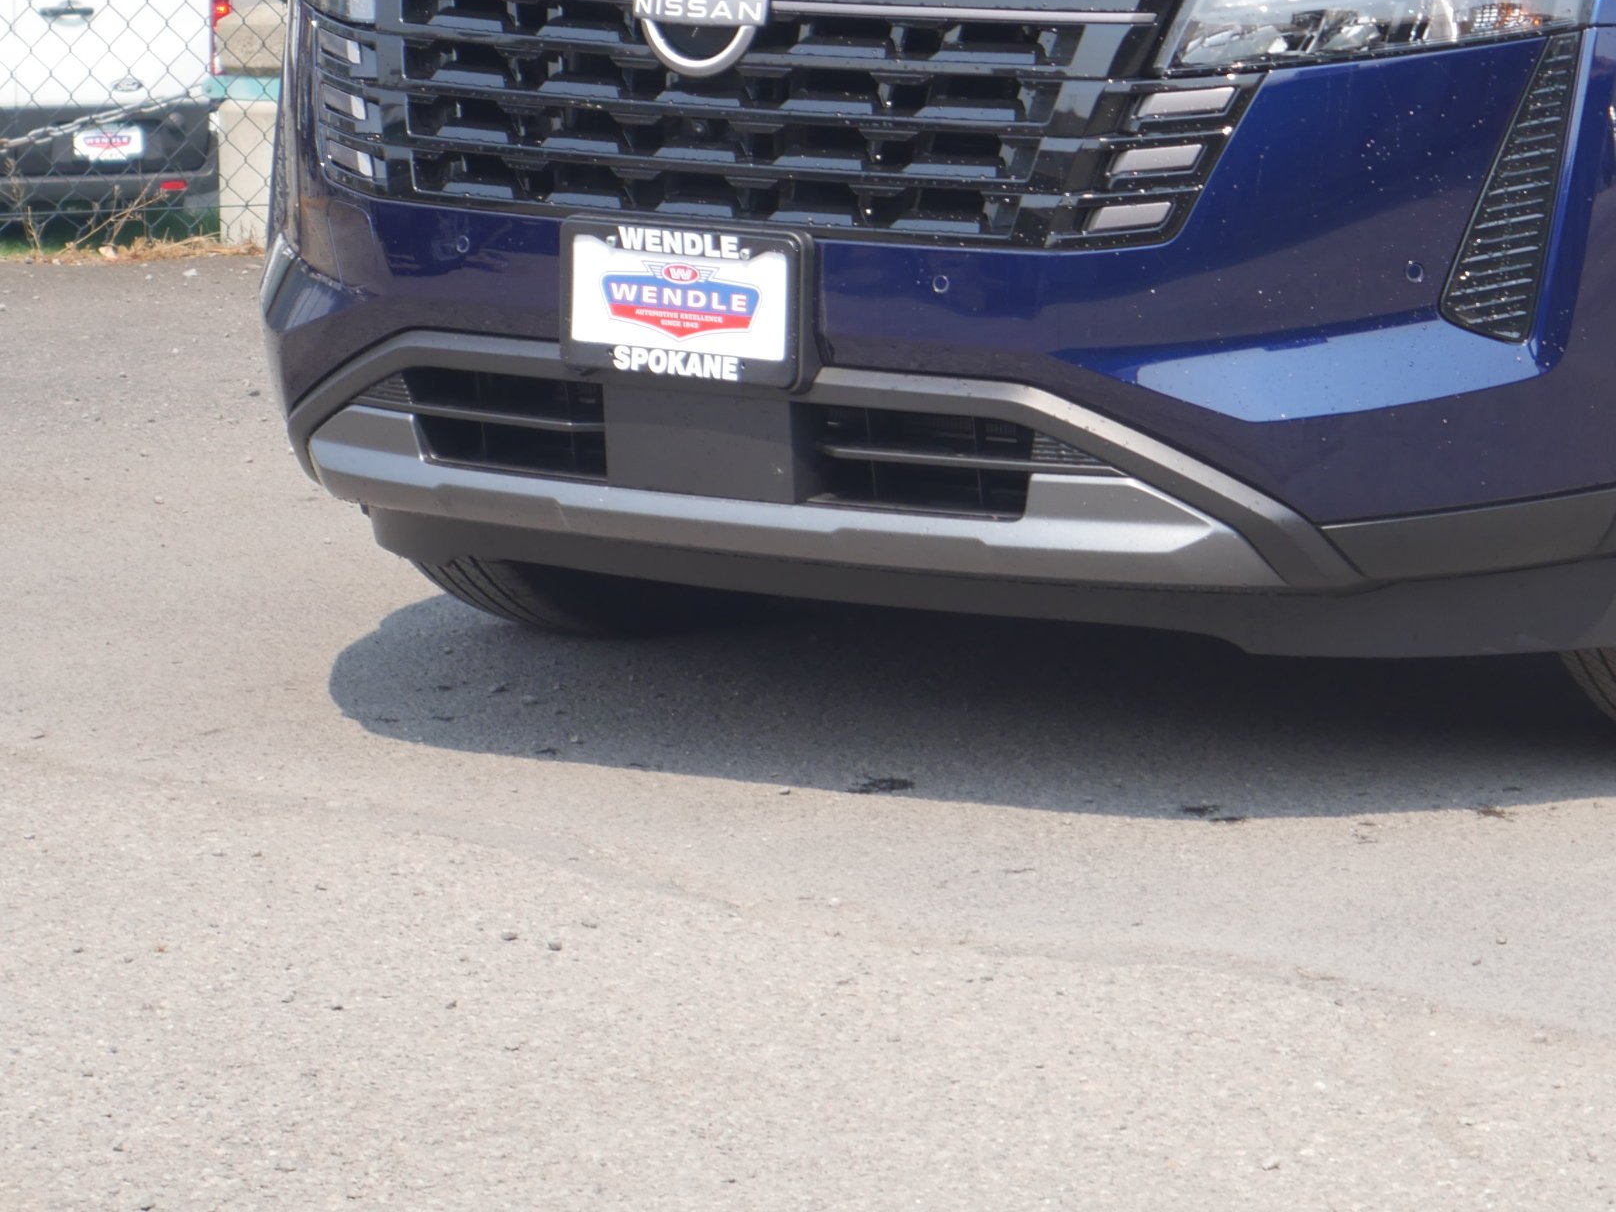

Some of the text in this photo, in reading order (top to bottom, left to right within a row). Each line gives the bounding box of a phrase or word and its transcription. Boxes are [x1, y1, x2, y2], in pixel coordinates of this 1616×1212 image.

[618, 226, 739, 260] WENDLE
[611, 282, 748, 312] WENDLE
[613, 345, 739, 381] SPOKANE
